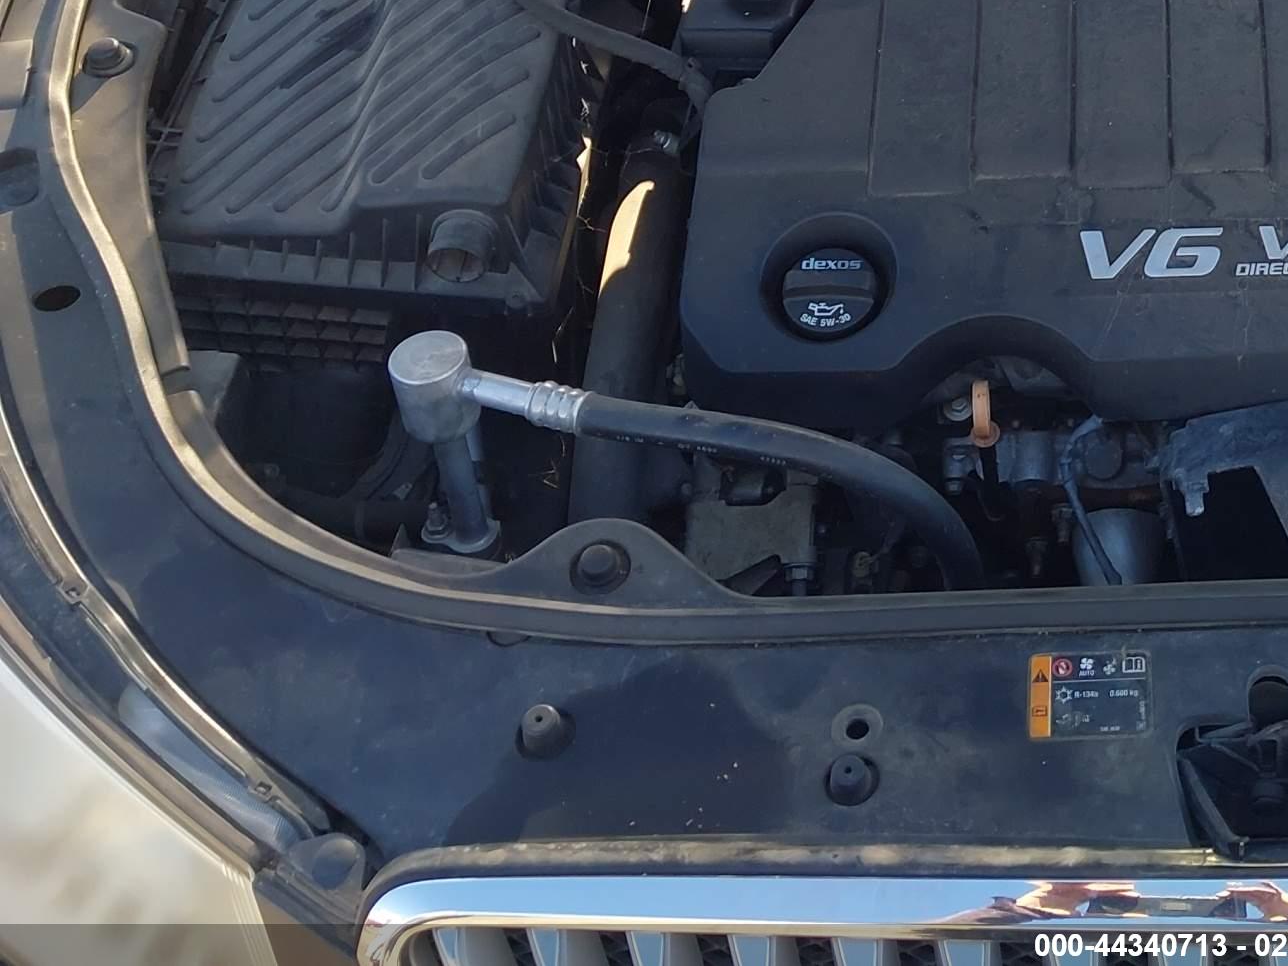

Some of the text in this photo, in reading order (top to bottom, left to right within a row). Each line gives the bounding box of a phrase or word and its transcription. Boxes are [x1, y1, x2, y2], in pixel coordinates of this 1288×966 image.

[1079, 227, 1224, 279] V6
[801, 257, 864, 270] dexos
[800, 313, 851, 327] SAE 5W-30
